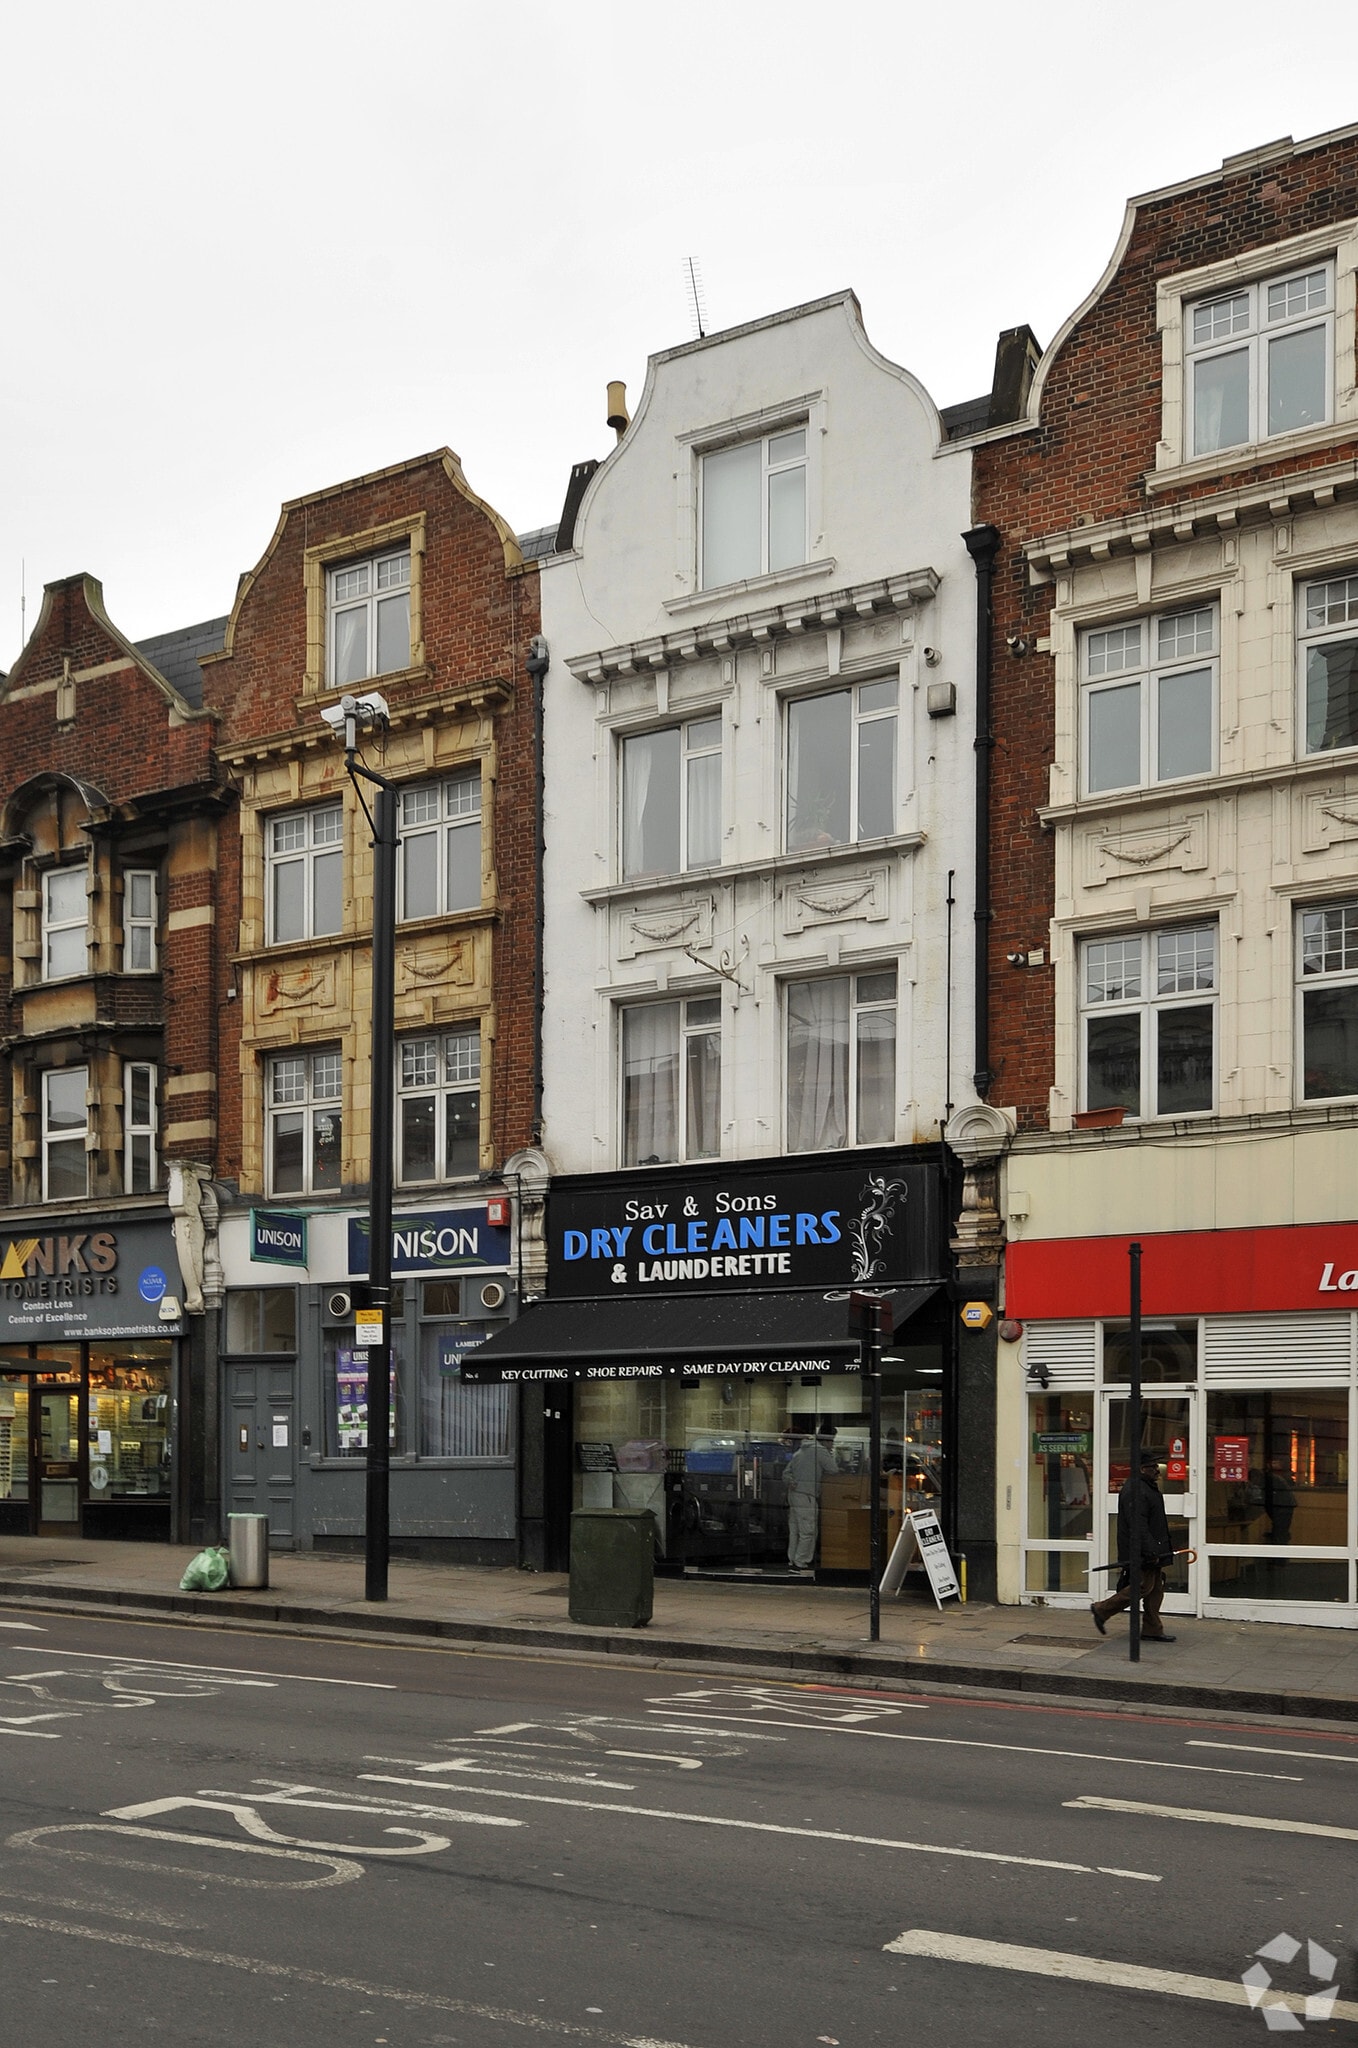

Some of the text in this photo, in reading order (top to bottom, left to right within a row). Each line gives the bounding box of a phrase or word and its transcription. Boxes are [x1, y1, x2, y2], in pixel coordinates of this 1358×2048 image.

[625, 1192, 776, 1221] Sav & Sons
[257, 1229, 301, 1248] UNISON
[393, 1227, 478, 1259] NISON
[563, 1210, 841, 1260] DRY CLEANERS
[611, 1253, 791, 1284] & LAUNDERETTE
[23, 1300, 73, 1311] Contact Lens
[8, 1312, 88, 1324] Centre of Excellence
[64, 1323, 180, 1336] www.banksoptometrists.co.uk
[501, 1360, 831, 1380] KEY CUTTING SHOE REPAIRS SAME DAY DRY CLEANING
[1039, 1444, 1048, 1453] AS
[1049, 1444, 1066, 1453] SEEN
